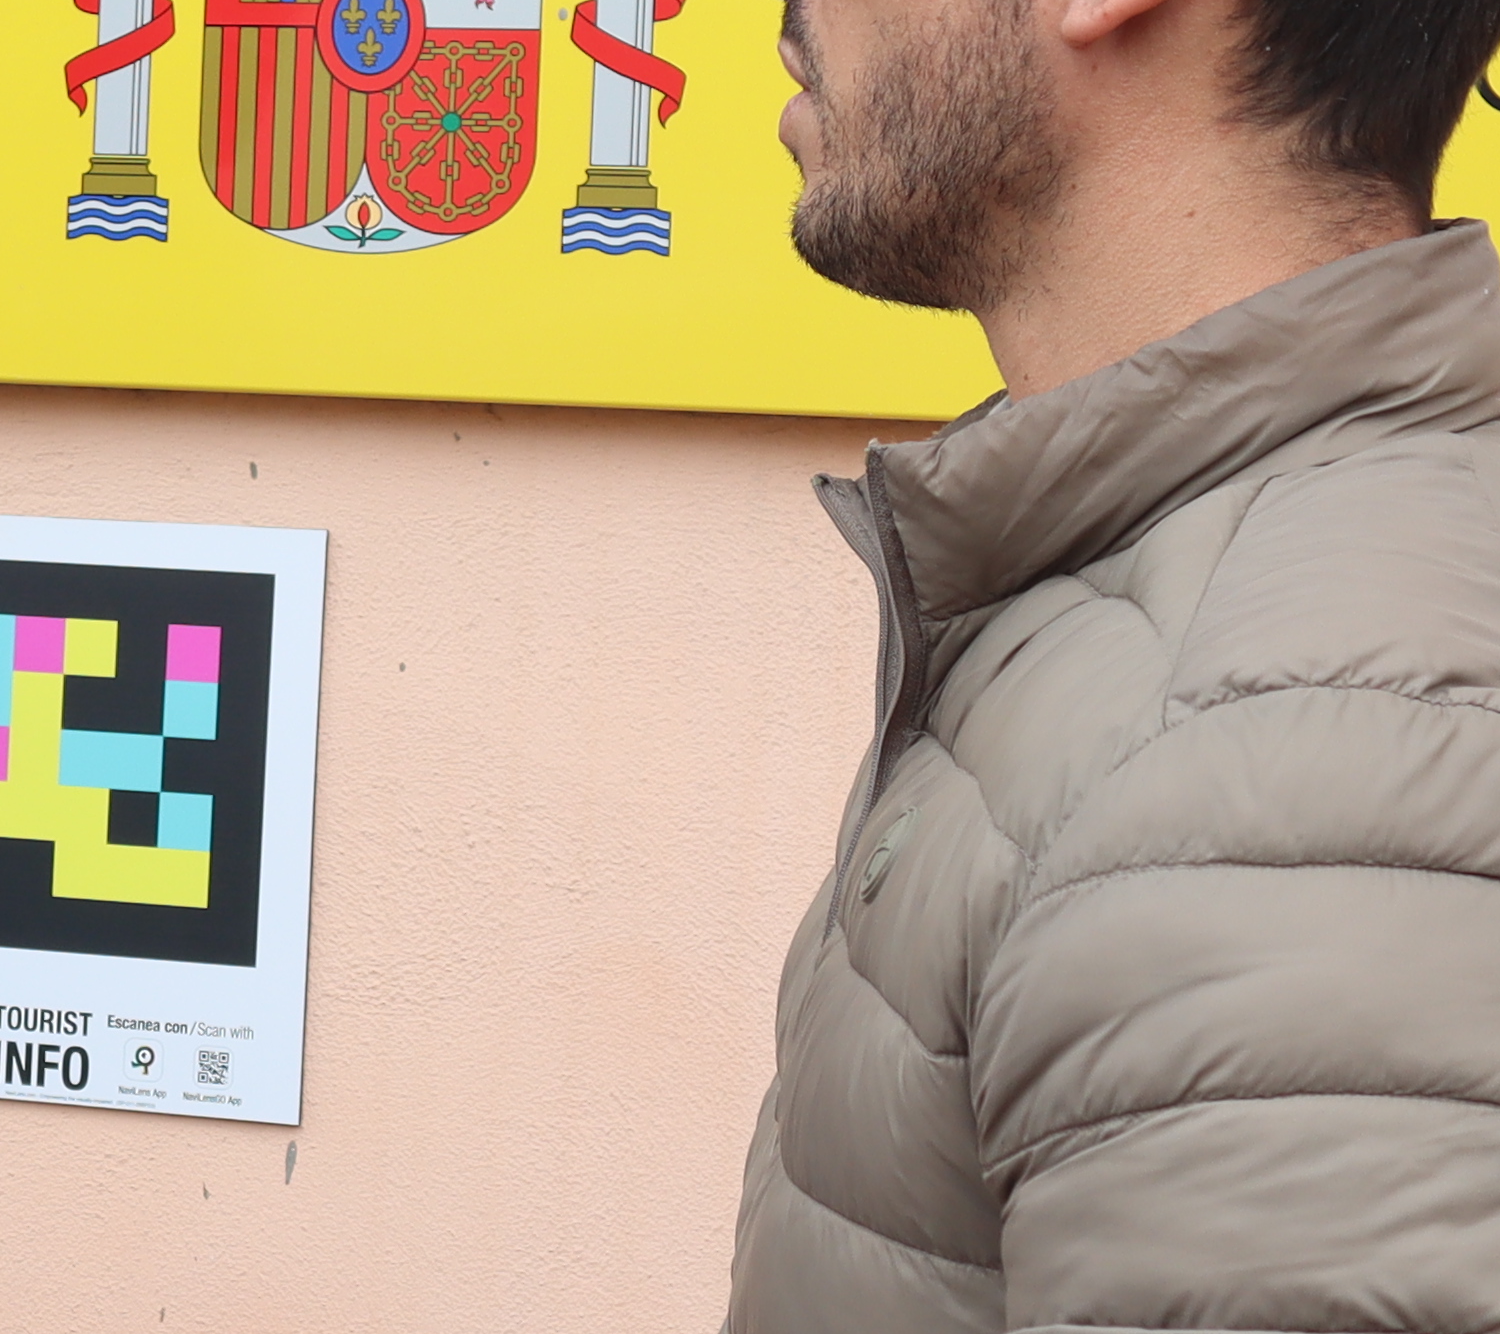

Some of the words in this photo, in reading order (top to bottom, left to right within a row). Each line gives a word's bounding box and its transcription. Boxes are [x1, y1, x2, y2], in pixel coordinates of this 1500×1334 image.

[107, 1014, 161, 1033] Escanea
[230, 1025, 254, 1041] with
[118, 1086, 151, 1098] NaviLens
[152, 1088, 167, 1100] App
[227, 1095, 242, 1107] App
